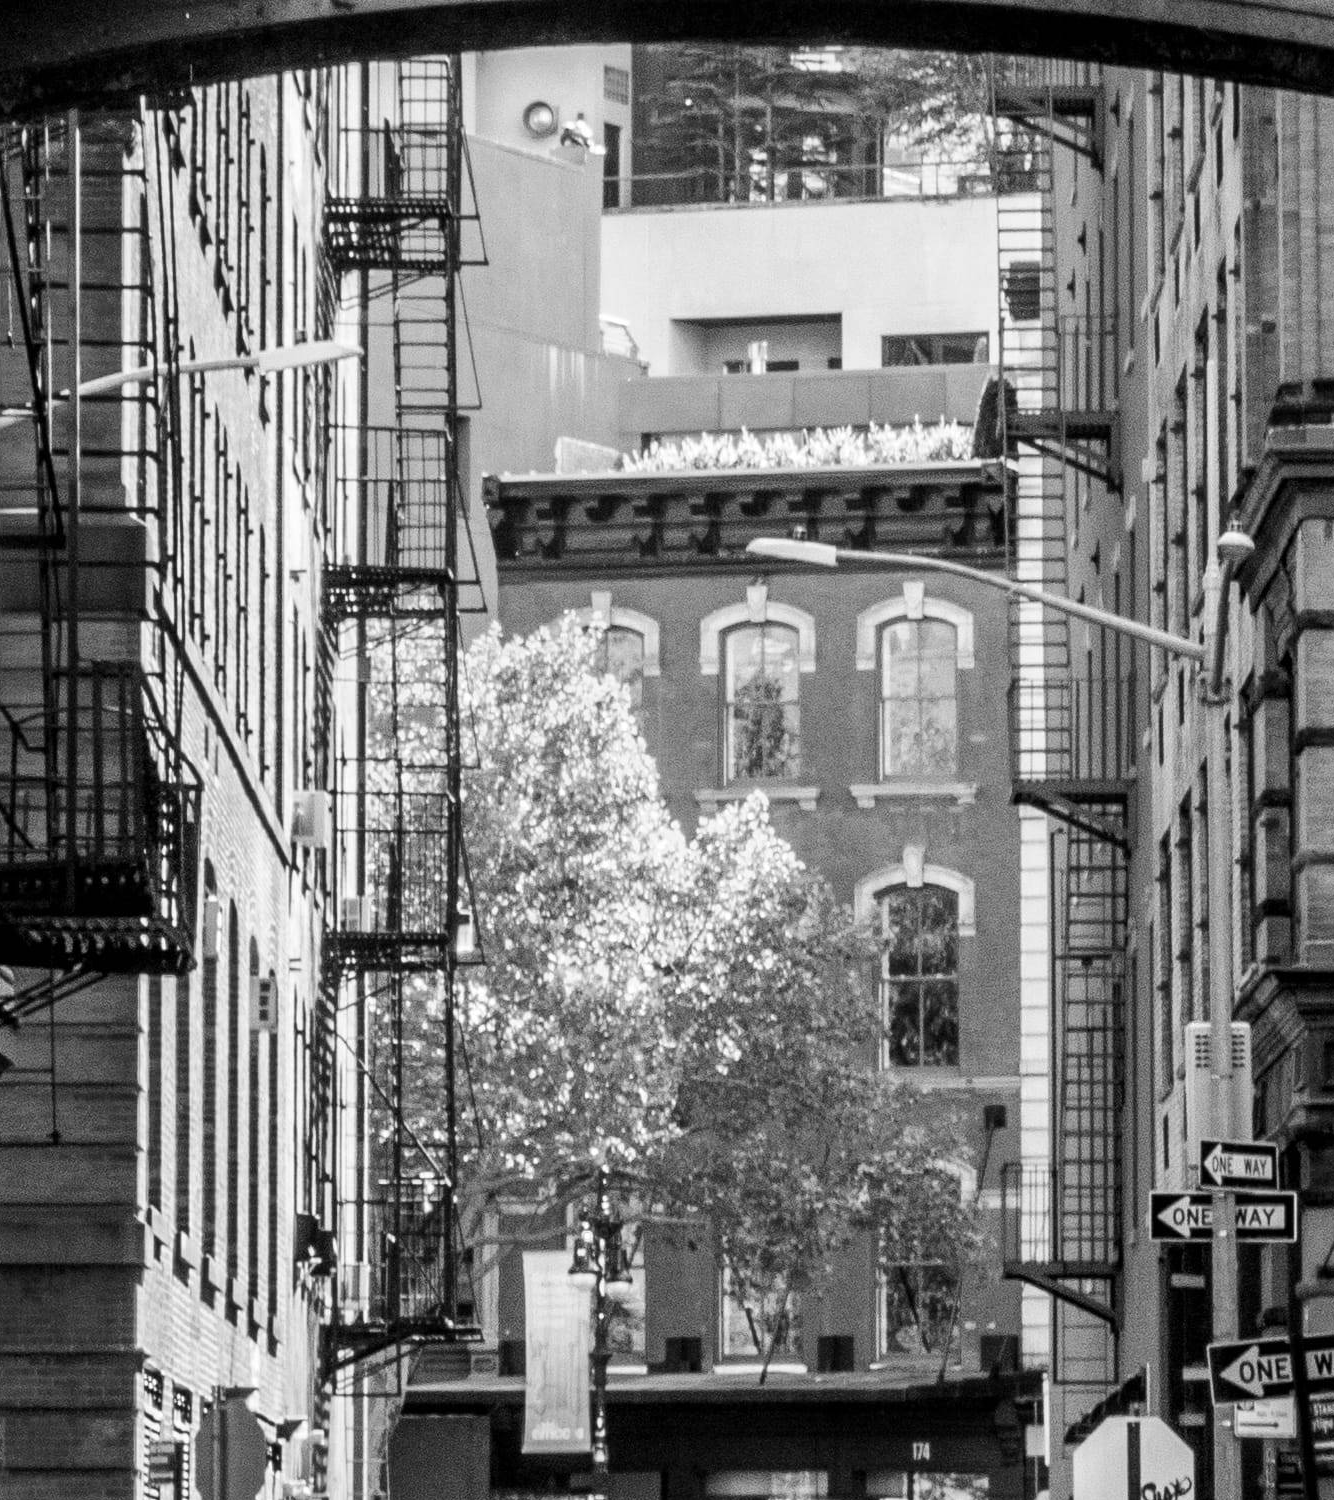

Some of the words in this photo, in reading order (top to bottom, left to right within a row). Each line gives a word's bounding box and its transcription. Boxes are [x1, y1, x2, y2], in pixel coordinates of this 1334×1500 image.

[1211, 1156, 1234, 1174] ONE
[1244, 1158, 1268, 1176] WAY
[1172, 1207, 1212, 1226] ONE
[1235, 1207, 1275, 1226] WAY
[1239, 1357, 1290, 1384] ONE
[912, 1441, 931, 1461] 174
